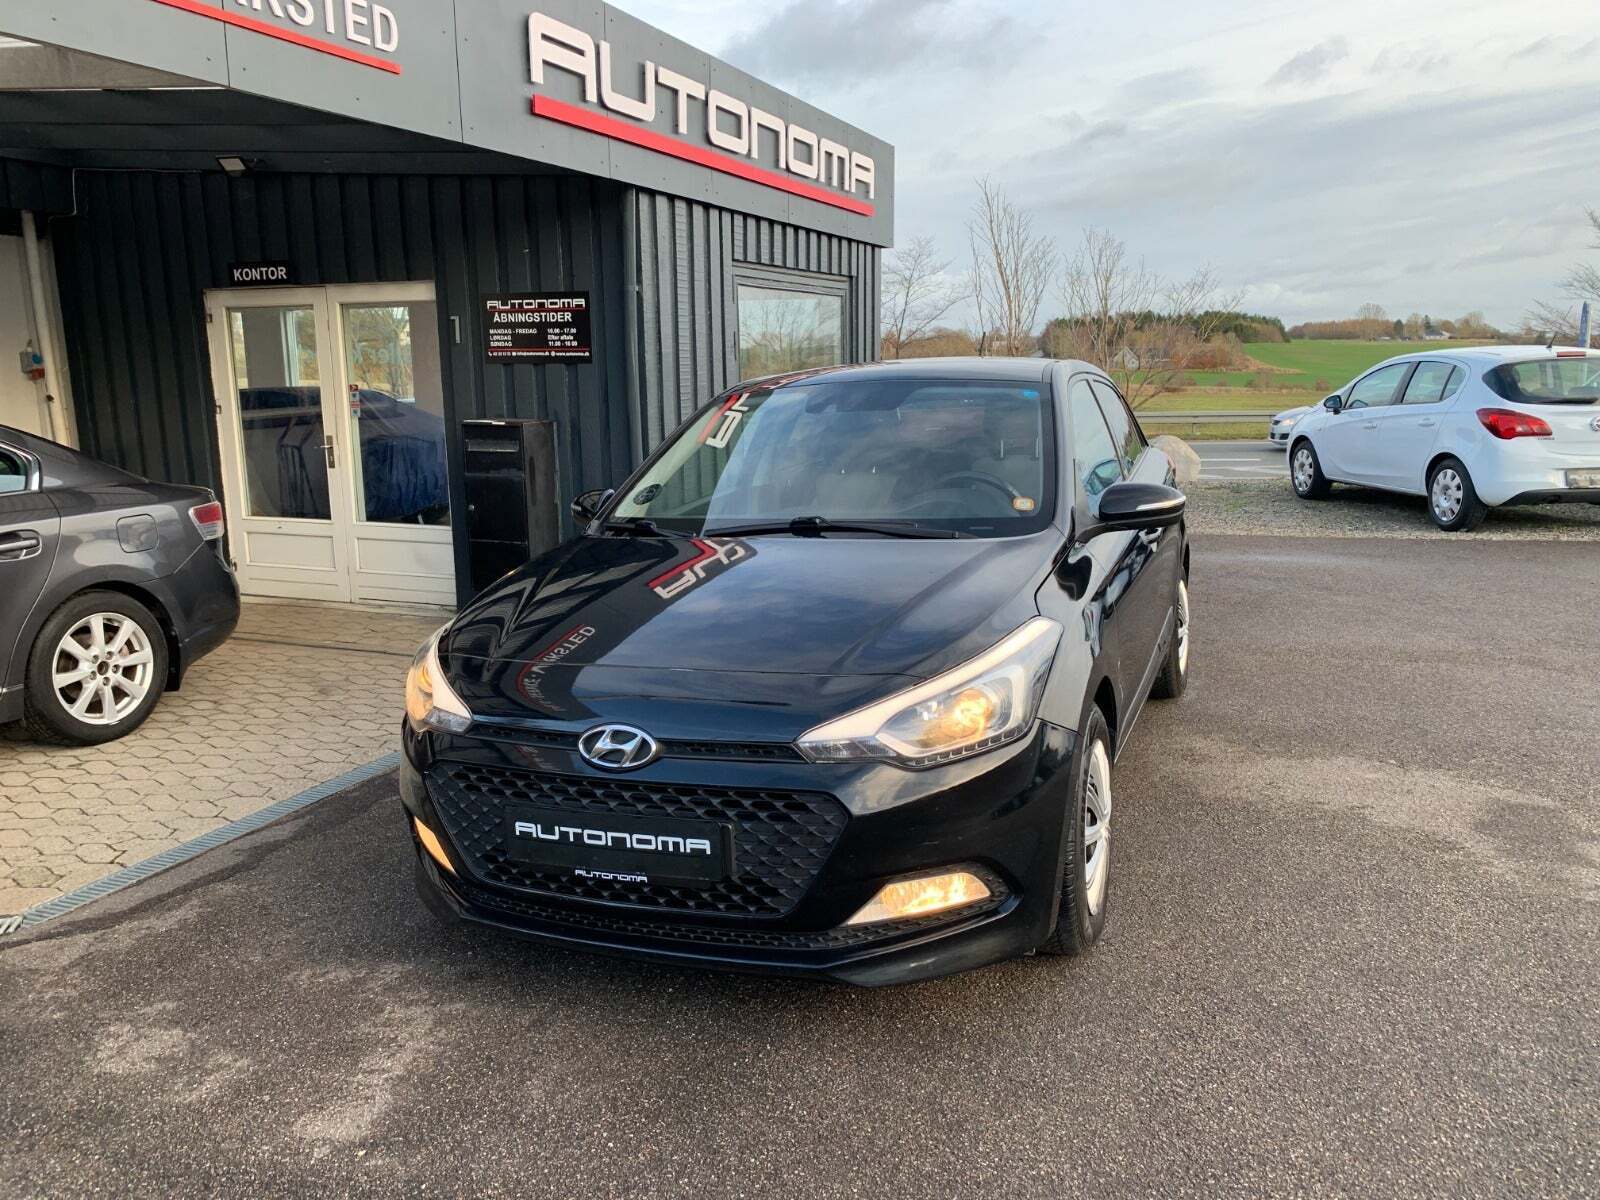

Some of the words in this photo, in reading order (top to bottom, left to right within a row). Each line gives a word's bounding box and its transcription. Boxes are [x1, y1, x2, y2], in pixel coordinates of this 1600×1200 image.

[236, 0, 399, 53] STED
[528, 11, 875, 200] AUTONOMA
[233, 266, 287, 281] KONTOR
[487, 298, 585, 310] AUTONOMA
[493, 312, 573, 322] ÅBNINGSTIDER
[515, 821, 711, 855] AUTONOMA
[574, 869, 648, 883] AUTONOMA
